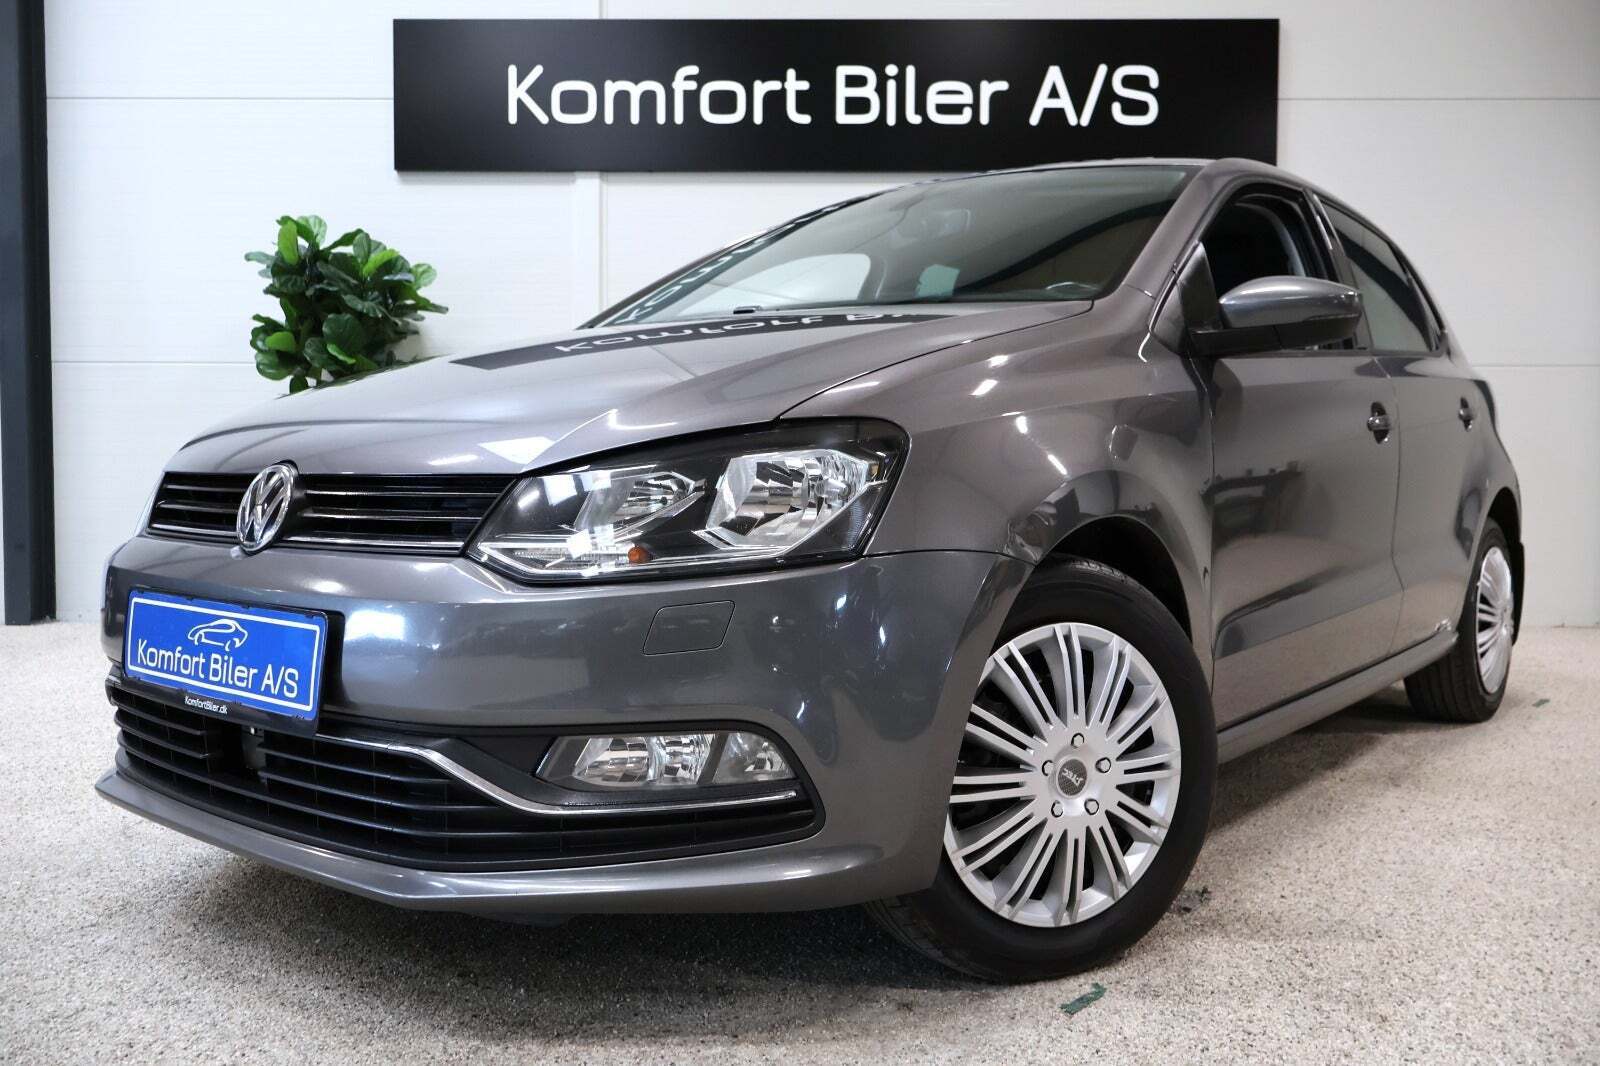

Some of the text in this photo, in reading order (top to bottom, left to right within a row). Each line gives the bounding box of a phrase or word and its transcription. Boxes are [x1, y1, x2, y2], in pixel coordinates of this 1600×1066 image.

[507, 63, 1160, 127] Komfort Biler A/S
[137, 639, 299, 699] Komfort Biler A/S
[184, 695, 228, 716] KomfortBiler.dk
